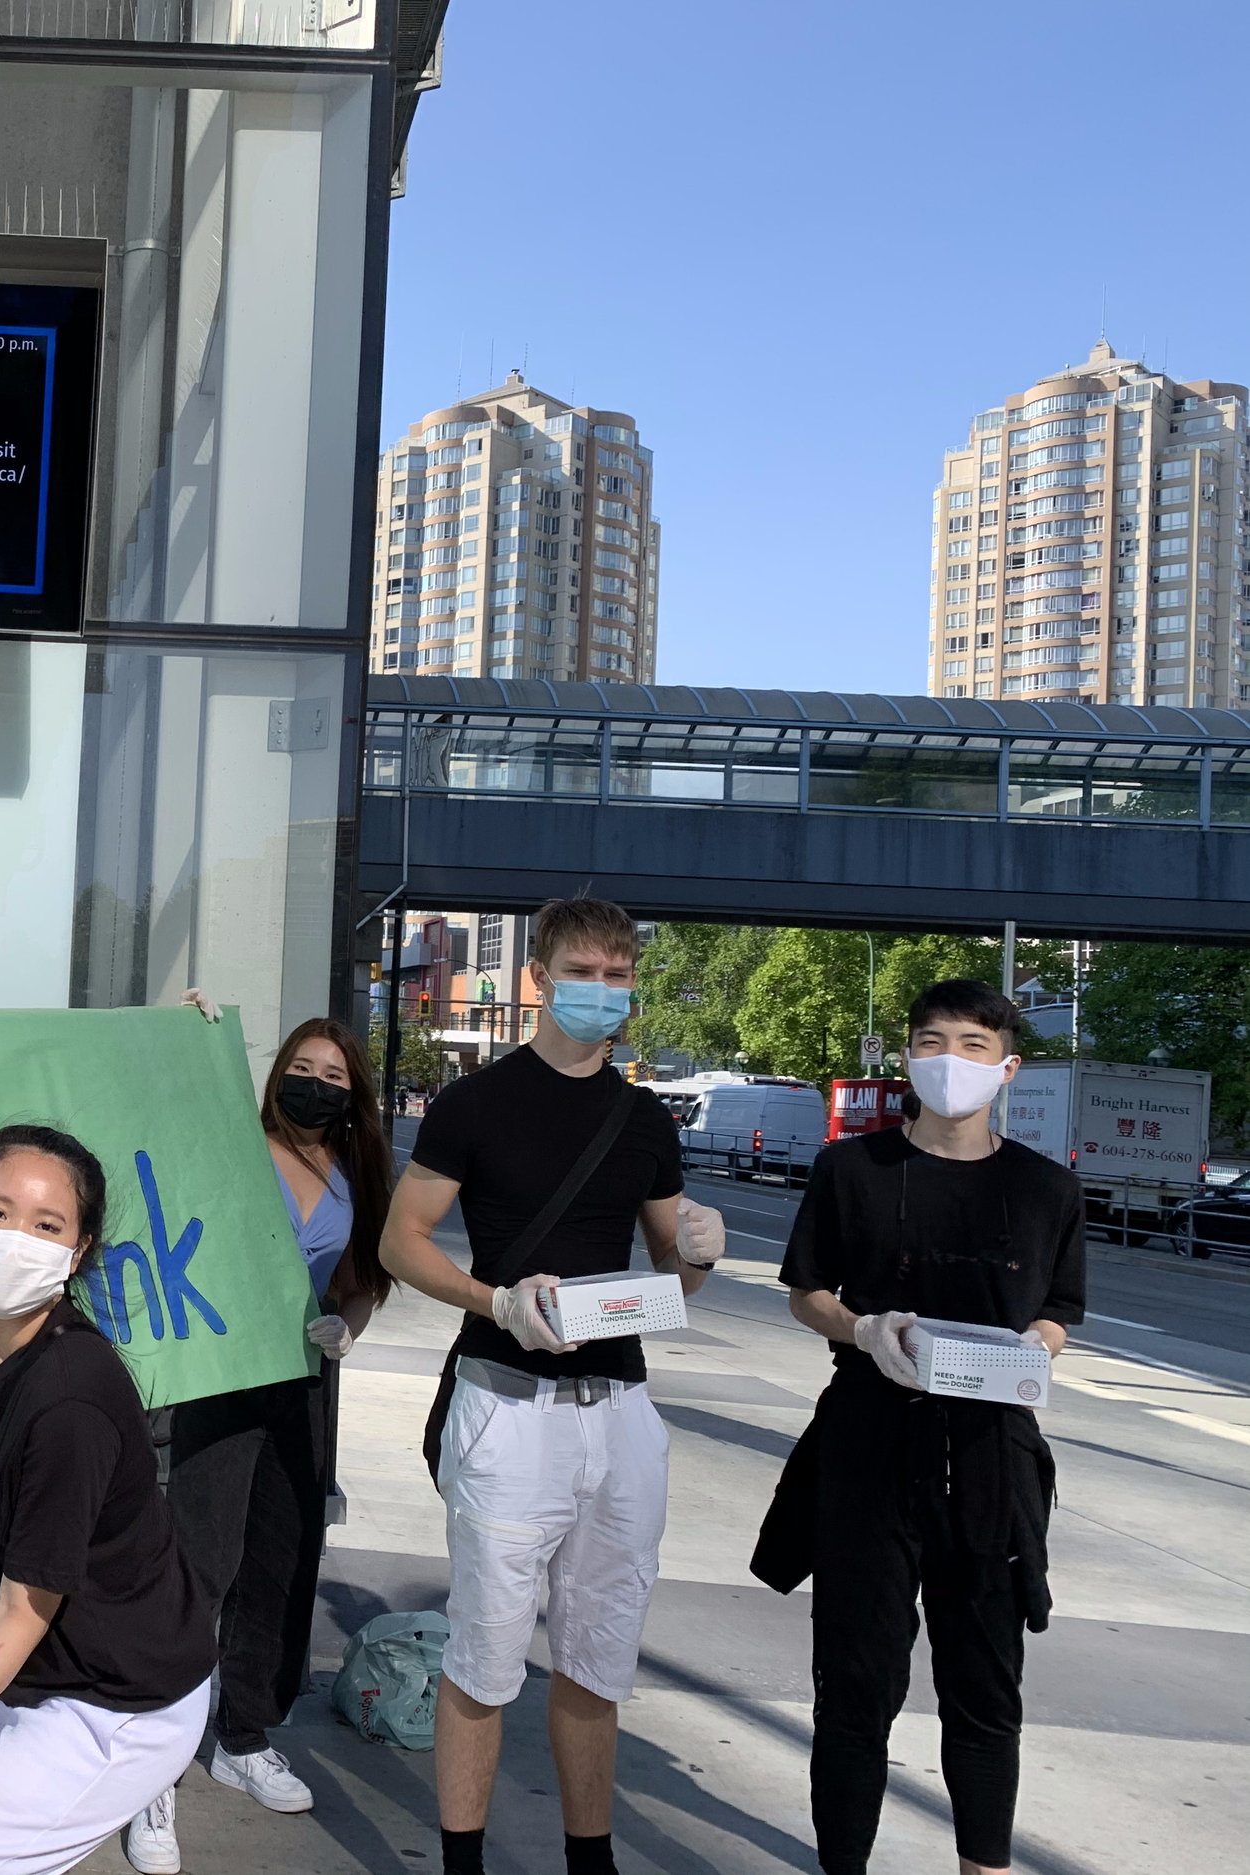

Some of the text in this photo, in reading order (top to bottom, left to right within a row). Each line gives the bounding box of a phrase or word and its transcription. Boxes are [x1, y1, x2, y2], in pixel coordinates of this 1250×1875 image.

[9, 338, 38, 352] p.m.
[835, 1087, 878, 1109] MILANI
[1013, 1086, 1056, 1099] Enterprise Inc
[1091, 1095, 1190, 1115] Bright Harvest
[1116, 1118, 1162, 1141] 豐隆
[1102, 1144, 1192, 1163] 604-278-6680
[600, 1313, 646, 1323] FUNDRAISING
[934, 1371, 955, 1380] NEED
[963, 1375, 985, 1384] RAISE
[950, 1381, 982, 1390] DOUGH?
